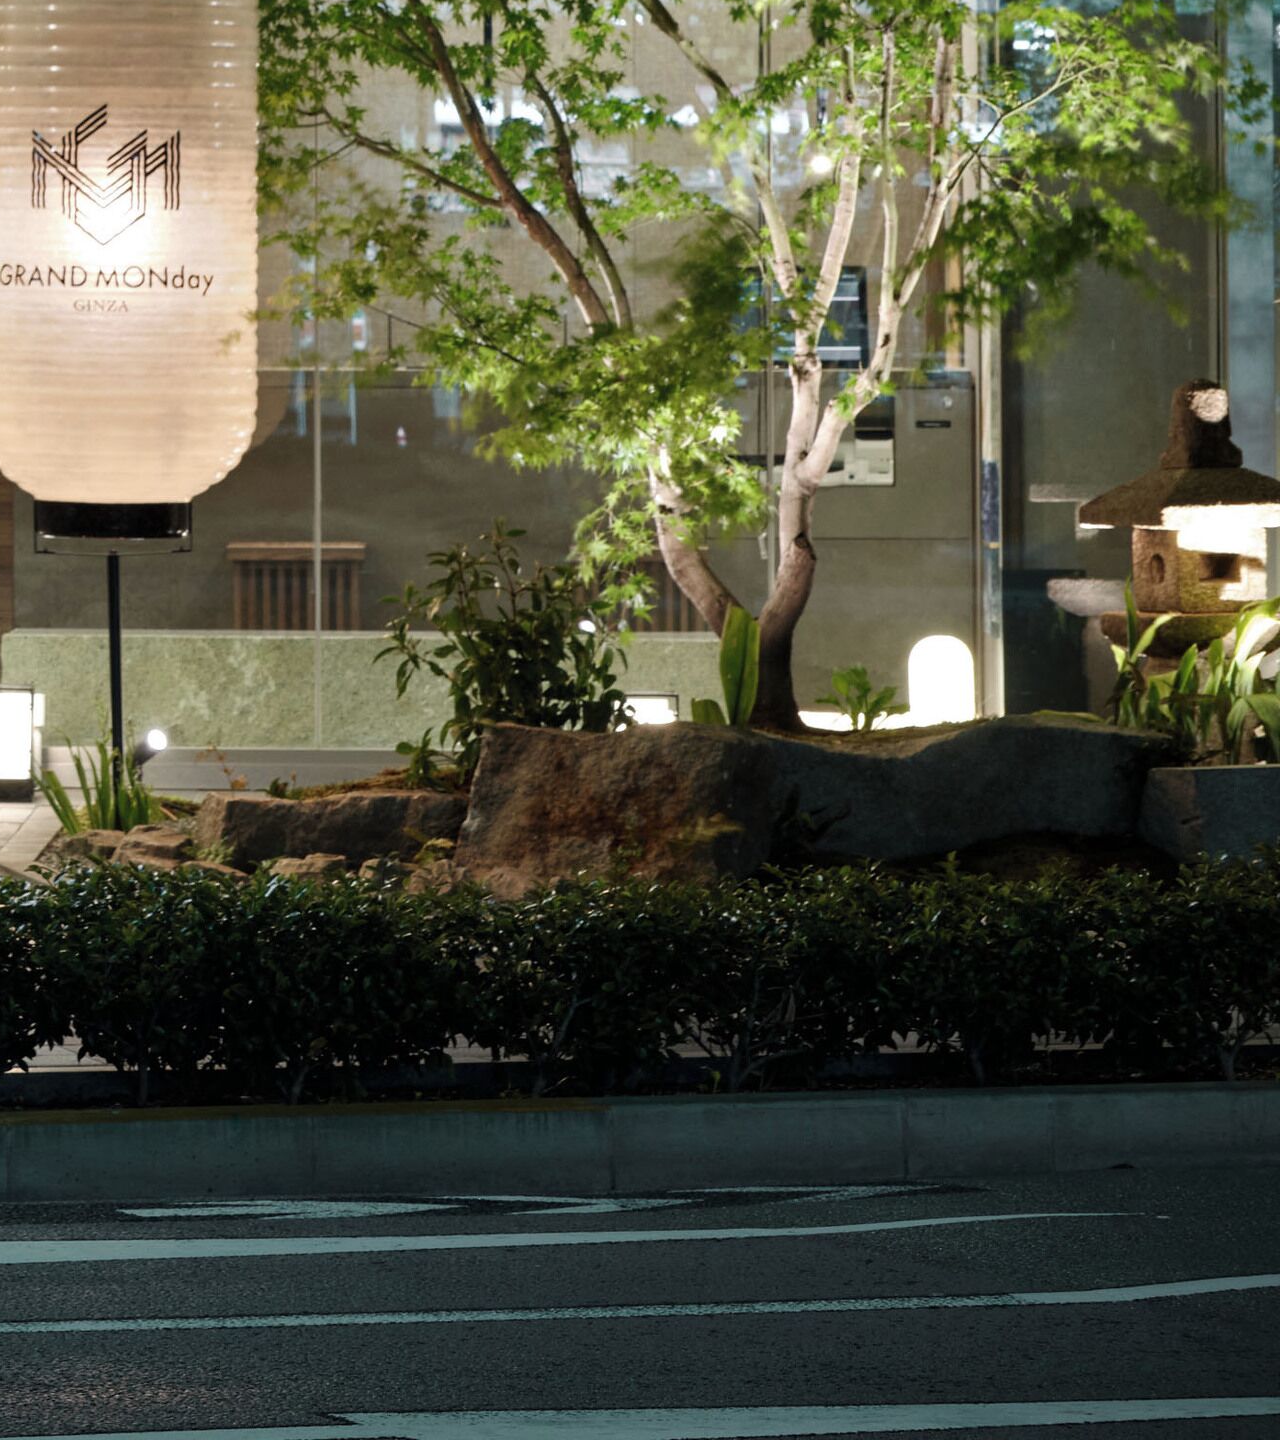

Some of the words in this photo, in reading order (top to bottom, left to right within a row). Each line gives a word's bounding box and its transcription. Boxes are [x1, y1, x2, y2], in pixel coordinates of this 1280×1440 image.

[0, 263, 88, 287] GRAND
[95, 264, 215, 297] MONday
[72, 299, 130, 314] GINZA
